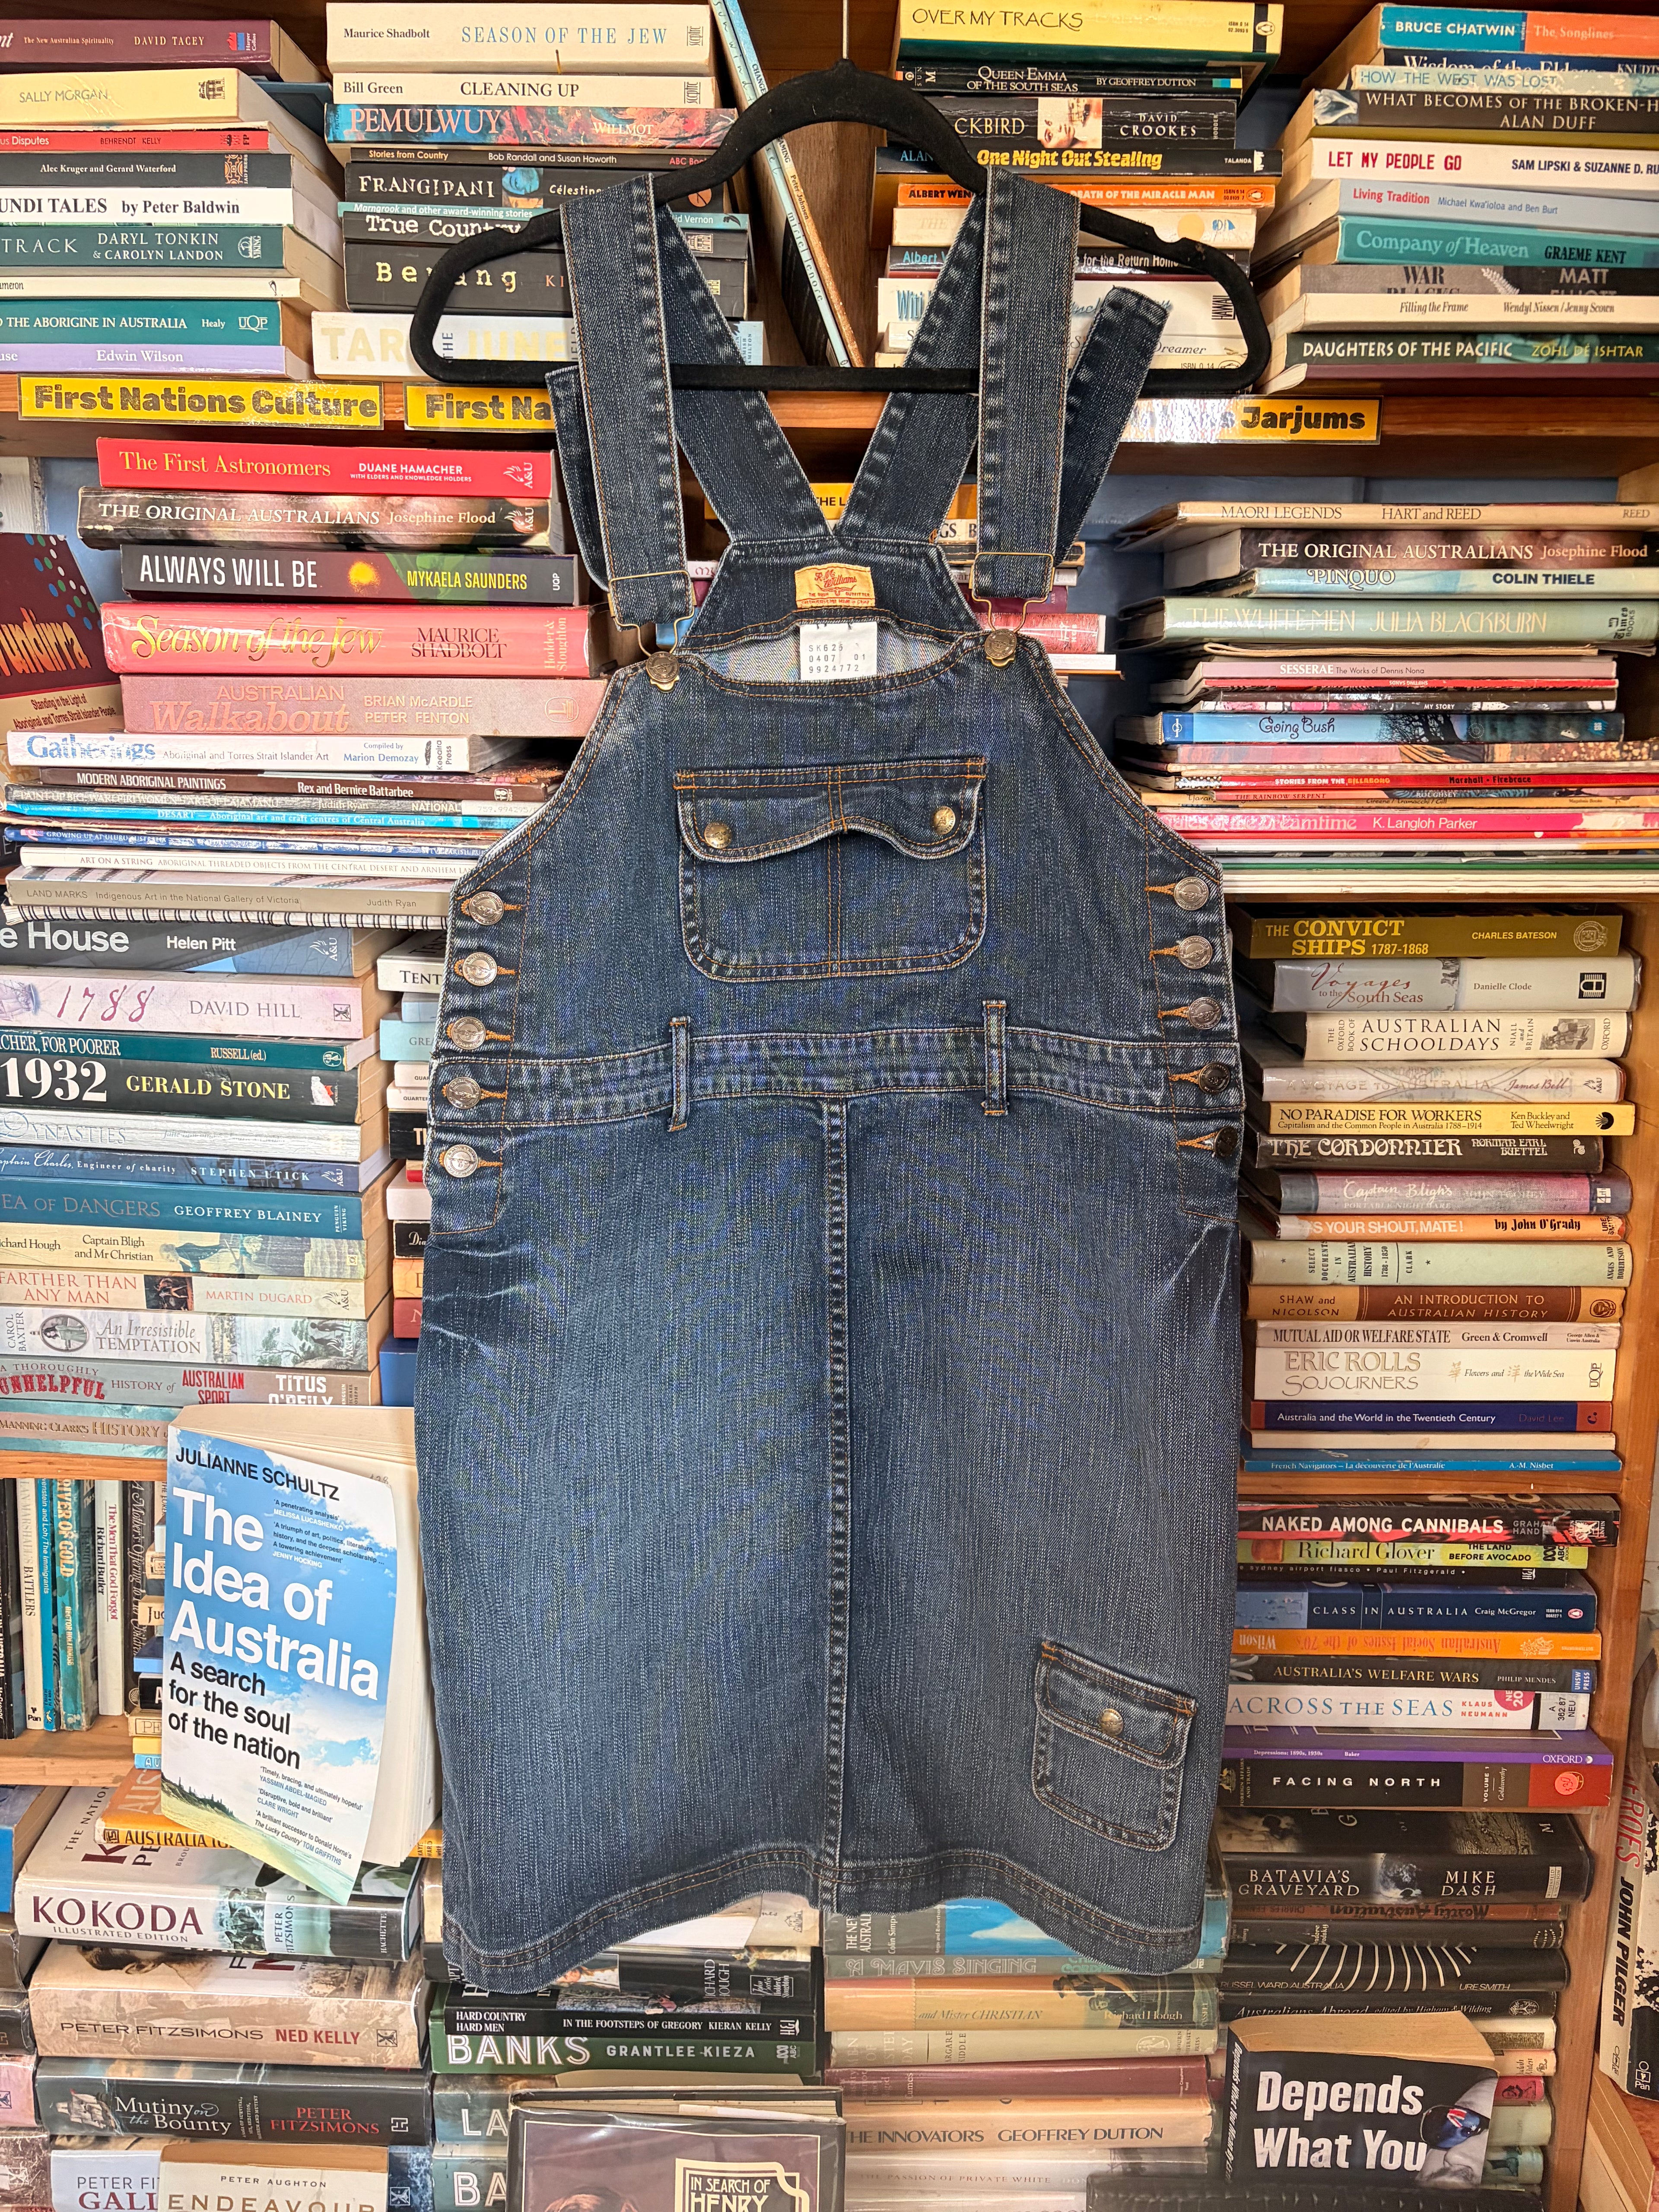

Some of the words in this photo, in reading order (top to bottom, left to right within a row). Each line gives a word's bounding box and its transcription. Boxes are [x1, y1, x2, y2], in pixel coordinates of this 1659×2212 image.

[912, 9, 964, 25] OVER
[970, 11, 995, 25] MY
[1000, 11, 1083, 32] TRACKS
[134, 36, 166, 45] DAVID
[172, 36, 205, 46] TACEY
[344, 29, 383, 38] Maurice
[386, 29, 430, 38] Shadbolt
[461, 27, 536, 44] SEASON
[545, 27, 569, 44] OF
[578, 28, 617, 44] THE
[627, 28, 667, 44] JEW
[19, 91, 51, 102] SALLY
[55, 89, 108, 101] MORGAN
[350, 109, 501, 135] PEMULWUY
[1500, 115, 1544, 128] ALAN
[1553, 117, 1596, 129] DUFF
[1120, 125, 1197, 136] CROOKES
[977, 150, 1009, 165] One
[1012, 150, 1058, 166] Night
[1062, 151, 1091, 166] Out
[1094, 152, 1163, 170] Stealing
[1328, 152, 1353, 167] LET
[1362, 153, 1378, 168] MY
[1386, 153, 1435, 169] PEOPLE
[1444, 156, 1462, 170] GO
[359, 175, 494, 197] FRANGIPANI
[1353, 189, 1383, 203] Living
[1387, 191, 1430, 204] Tradition
[122, 201, 138, 214] by
[143, 201, 178, 214] Peter
[183, 200, 240, 213] Baldwin
[98, 232, 148, 245] DARYL
[155, 233, 218, 245] TONKIN
[1545, 246, 1592, 261] GRAEME
[1595, 250, 1626, 264] KENT
[1400, 302, 1427, 315] Filling
[1428, 303, 1440, 312] the
[1443, 302, 1468, 312] Frame
[239, 315, 268, 331] UQP
[96, 350, 137, 362] Edwin
[140, 350, 184, 362] Wilson
[1303, 341, 1393, 357] DAUGHTERS
[1398, 342, 1417, 356] OF
[1421, 342, 1450, 356] THE
[1455, 343, 1512, 357] PACIFIC
[35, 385, 113, 410] First
[119, 386, 246, 414] Nations
[251, 388, 378, 418] Culture
[1241, 406, 1366, 435] Jarjums
[120, 451, 157, 470] The
[164, 453, 208, 473] First
[216, 456, 331, 477] Astronomers
[359, 464, 397, 474] DUANE
[400, 464, 463, 474] HAMACHER
[388, 511, 454, 524] Josephine
[458, 512, 496, 524] Flood
[1221, 506, 1270, 520] MAORI
[1274, 506, 1341, 520] LEGENDS
[140, 555, 226, 585] ALWAYS
[233, 558, 284, 587] WILL
[293, 561, 317, 588] BE
[1492, 572, 1539, 586] COLIN
[1543, 572, 1595, 585] THIELE
[407, 570, 461, 588] MYKAELA
[465, 572, 527, 590] SAUNDERS
[417, 628, 499, 642] MAURICE
[411, 643, 507, 658] SHADBOLT
[809, 664, 858, 673] 9924772
[1280, 665, 1334, 674] SESSERAE
[344, 753, 374, 762] Marion
[378, 753, 419, 763] Demozay
[77, 773, 118, 786] MODERN
[120, 776, 175, 788] ABORIGINAL
[177, 777, 226, 790] PAINTINGS
[1373, 817, 1384, 829] K.
[1387, 816, 1434, 830] Langloh
[1439, 817, 1478, 830] Parker
[1266, 925, 1290, 936] THE
[1294, 920, 1404, 937] CONVICT
[167, 936, 209, 950] Helen
[213, 937, 236, 951] Pitt
[1292, 940, 1365, 955] SHIPS
[1371, 944, 1428, 955] 1787-1868
[57, 985, 154, 1023] 1788
[1361, 1018, 1500, 1033] AUSTRALIAN
[1360, 1037, 1500, 1051] SCHOOLDAYS
[126, 1076, 212, 1096] GERALD
[220, 1079, 289, 1100] STONE
[1527, 1121, 1573, 1130] Wheelwright
[174, 1205, 251, 1220] GEOFFREY
[257, 1210, 321, 1224] BLAINEY
[1495, 1220, 1508, 1231] by
[1511, 1220, 1536, 1230] John
[1539, 1219, 1581, 1231] O'Grady
[1462, 1332, 1490, 1341] Green
[1493, 1333, 1501, 1341] &
[1503, 1332, 1548, 1341] Cromwell
[96, 1337, 200, 1354] TEMPTATION
[175, 1446, 258, 1479] JULIANNE
[262, 1468, 340, 1501] SCHULTZ
[173, 1487, 264, 1550] The
[1262, 1516, 1322, 1532] NAKED
[1330, 1517, 1393, 1532] AMONG
[1402, 1518, 1503, 1534] CANNIBALS
[273, 1551, 293, 1560] JENNY
[294, 1556, 322, 1568] HOCKING
[23, 1566, 35, 1617] BATTLERS
[172, 1542, 269, 1611] Idea
[283, 1580, 333, 1626] of
[1388, 1607, 1468, 1616] AUSTRALIA
[170, 1600, 378, 1700] Australia
[1543, 1755, 1582, 1764] OXFORD
[1273, 1777, 1353, 1786] FACING
[1370, 1777, 1440, 1787] NORTH
[257, 1797, 276, 1809] CLARE
[277, 1805, 299, 1818] WRIGHT
[1249, 1869, 1350, 1883] BATAVIA'S
[1446, 1870, 1495, 1884] MIKE
[1238, 1883, 1359, 1897] GRAVEYARD
[1441, 1884, 1496, 1896] DASH
[33, 1896, 203, 1936] KOKODA
[1618, 1877, 1634, 1940] JOHN
[1612, 1940, 1630, 2027] PILGER
[60, 2022, 130, 2035] PETER
[137, 2024, 264, 2040] FITZSIMONS
[607, 2045, 696, 2057] GRANTLEE
[704, 2045, 755, 2058] KIEZA
[1256, 2071, 1423, 2121] Depends
[877, 2130, 984, 2143] INNOVATORS
[998, 2129, 1091, 2142] GEOFFREY
[1094, 2128, 1163, 2139] DUTTON
[1254, 2128, 1350, 2168] What
[1363, 2129, 1427, 2171] You
[221, 2176, 259, 2184] PETER
[267, 2178, 326, 2188] AUGHTON
